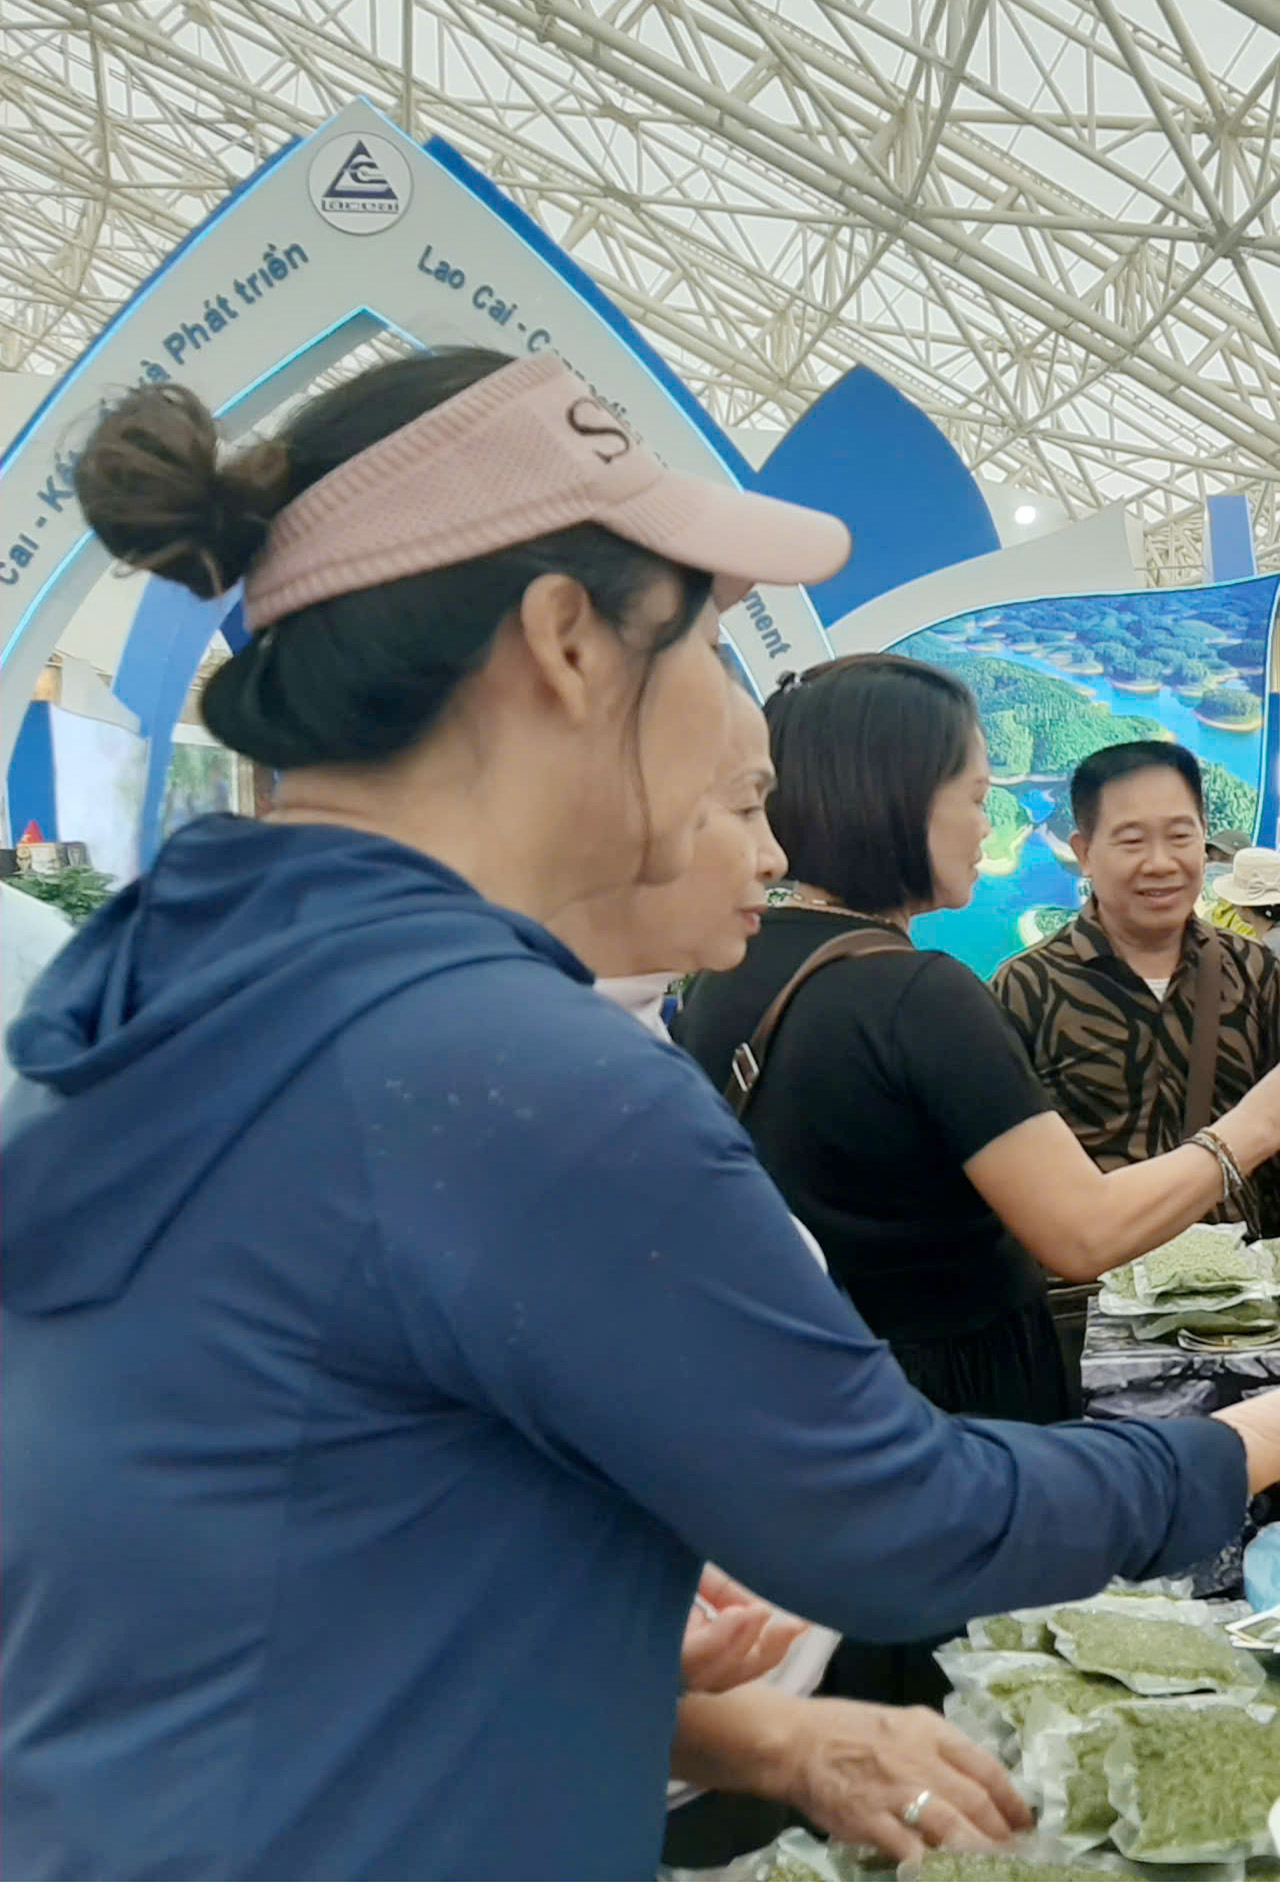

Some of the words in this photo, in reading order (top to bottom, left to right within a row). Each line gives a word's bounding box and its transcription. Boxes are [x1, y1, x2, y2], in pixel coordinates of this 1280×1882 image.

[162, 294, 239, 365] Phát
[233, 243, 310, 305] triển
[417, 245, 465, 290] Lao
[471, 285, 518, 327] Cai
